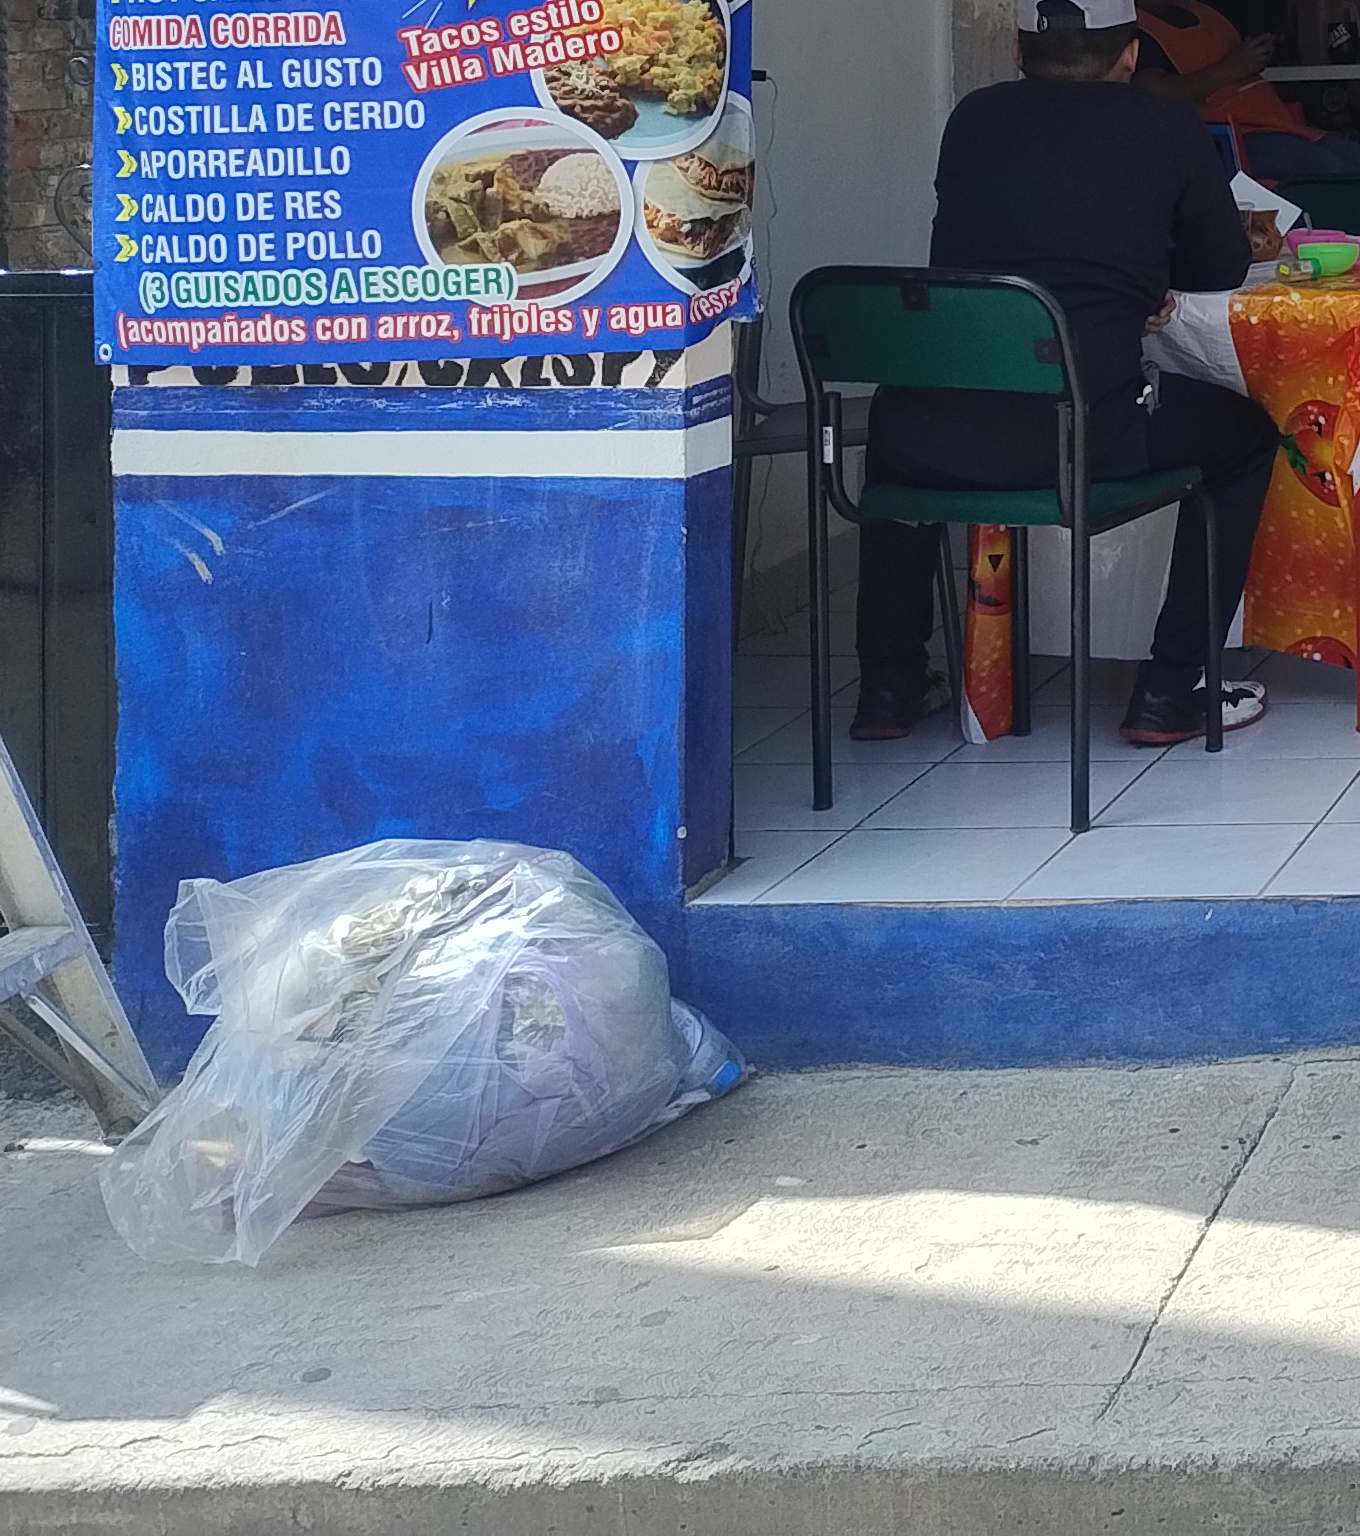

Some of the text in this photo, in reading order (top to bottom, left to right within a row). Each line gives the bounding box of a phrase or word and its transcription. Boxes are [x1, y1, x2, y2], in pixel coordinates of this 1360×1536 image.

[110, 11, 346, 50] COMIDA CORRIDA
[400, 18, 501, 57] Tacos
[132, 57, 382, 91] BISTEC AL GUSTO
[405, 28, 622, 89] Villa Madero
[135, 100, 425, 135] COSTILLA DE CERDO
[141, 146, 350, 179] APORREADILLO
[142, 190, 341, 222] CALDO DE RES
[142, 230, 381, 263] CALDO DE POLLO
[140, 264, 517, 311] (3 GUISADOS A ESCOGER)
[116, 312, 307, 351] (acompañados
[314, 313, 368, 343] con
[376, 310, 461, 343] arroz,
[467, 299, 574, 347] frijoles
[580, 309, 599, 339] y
[609, 299, 684, 335] agua
